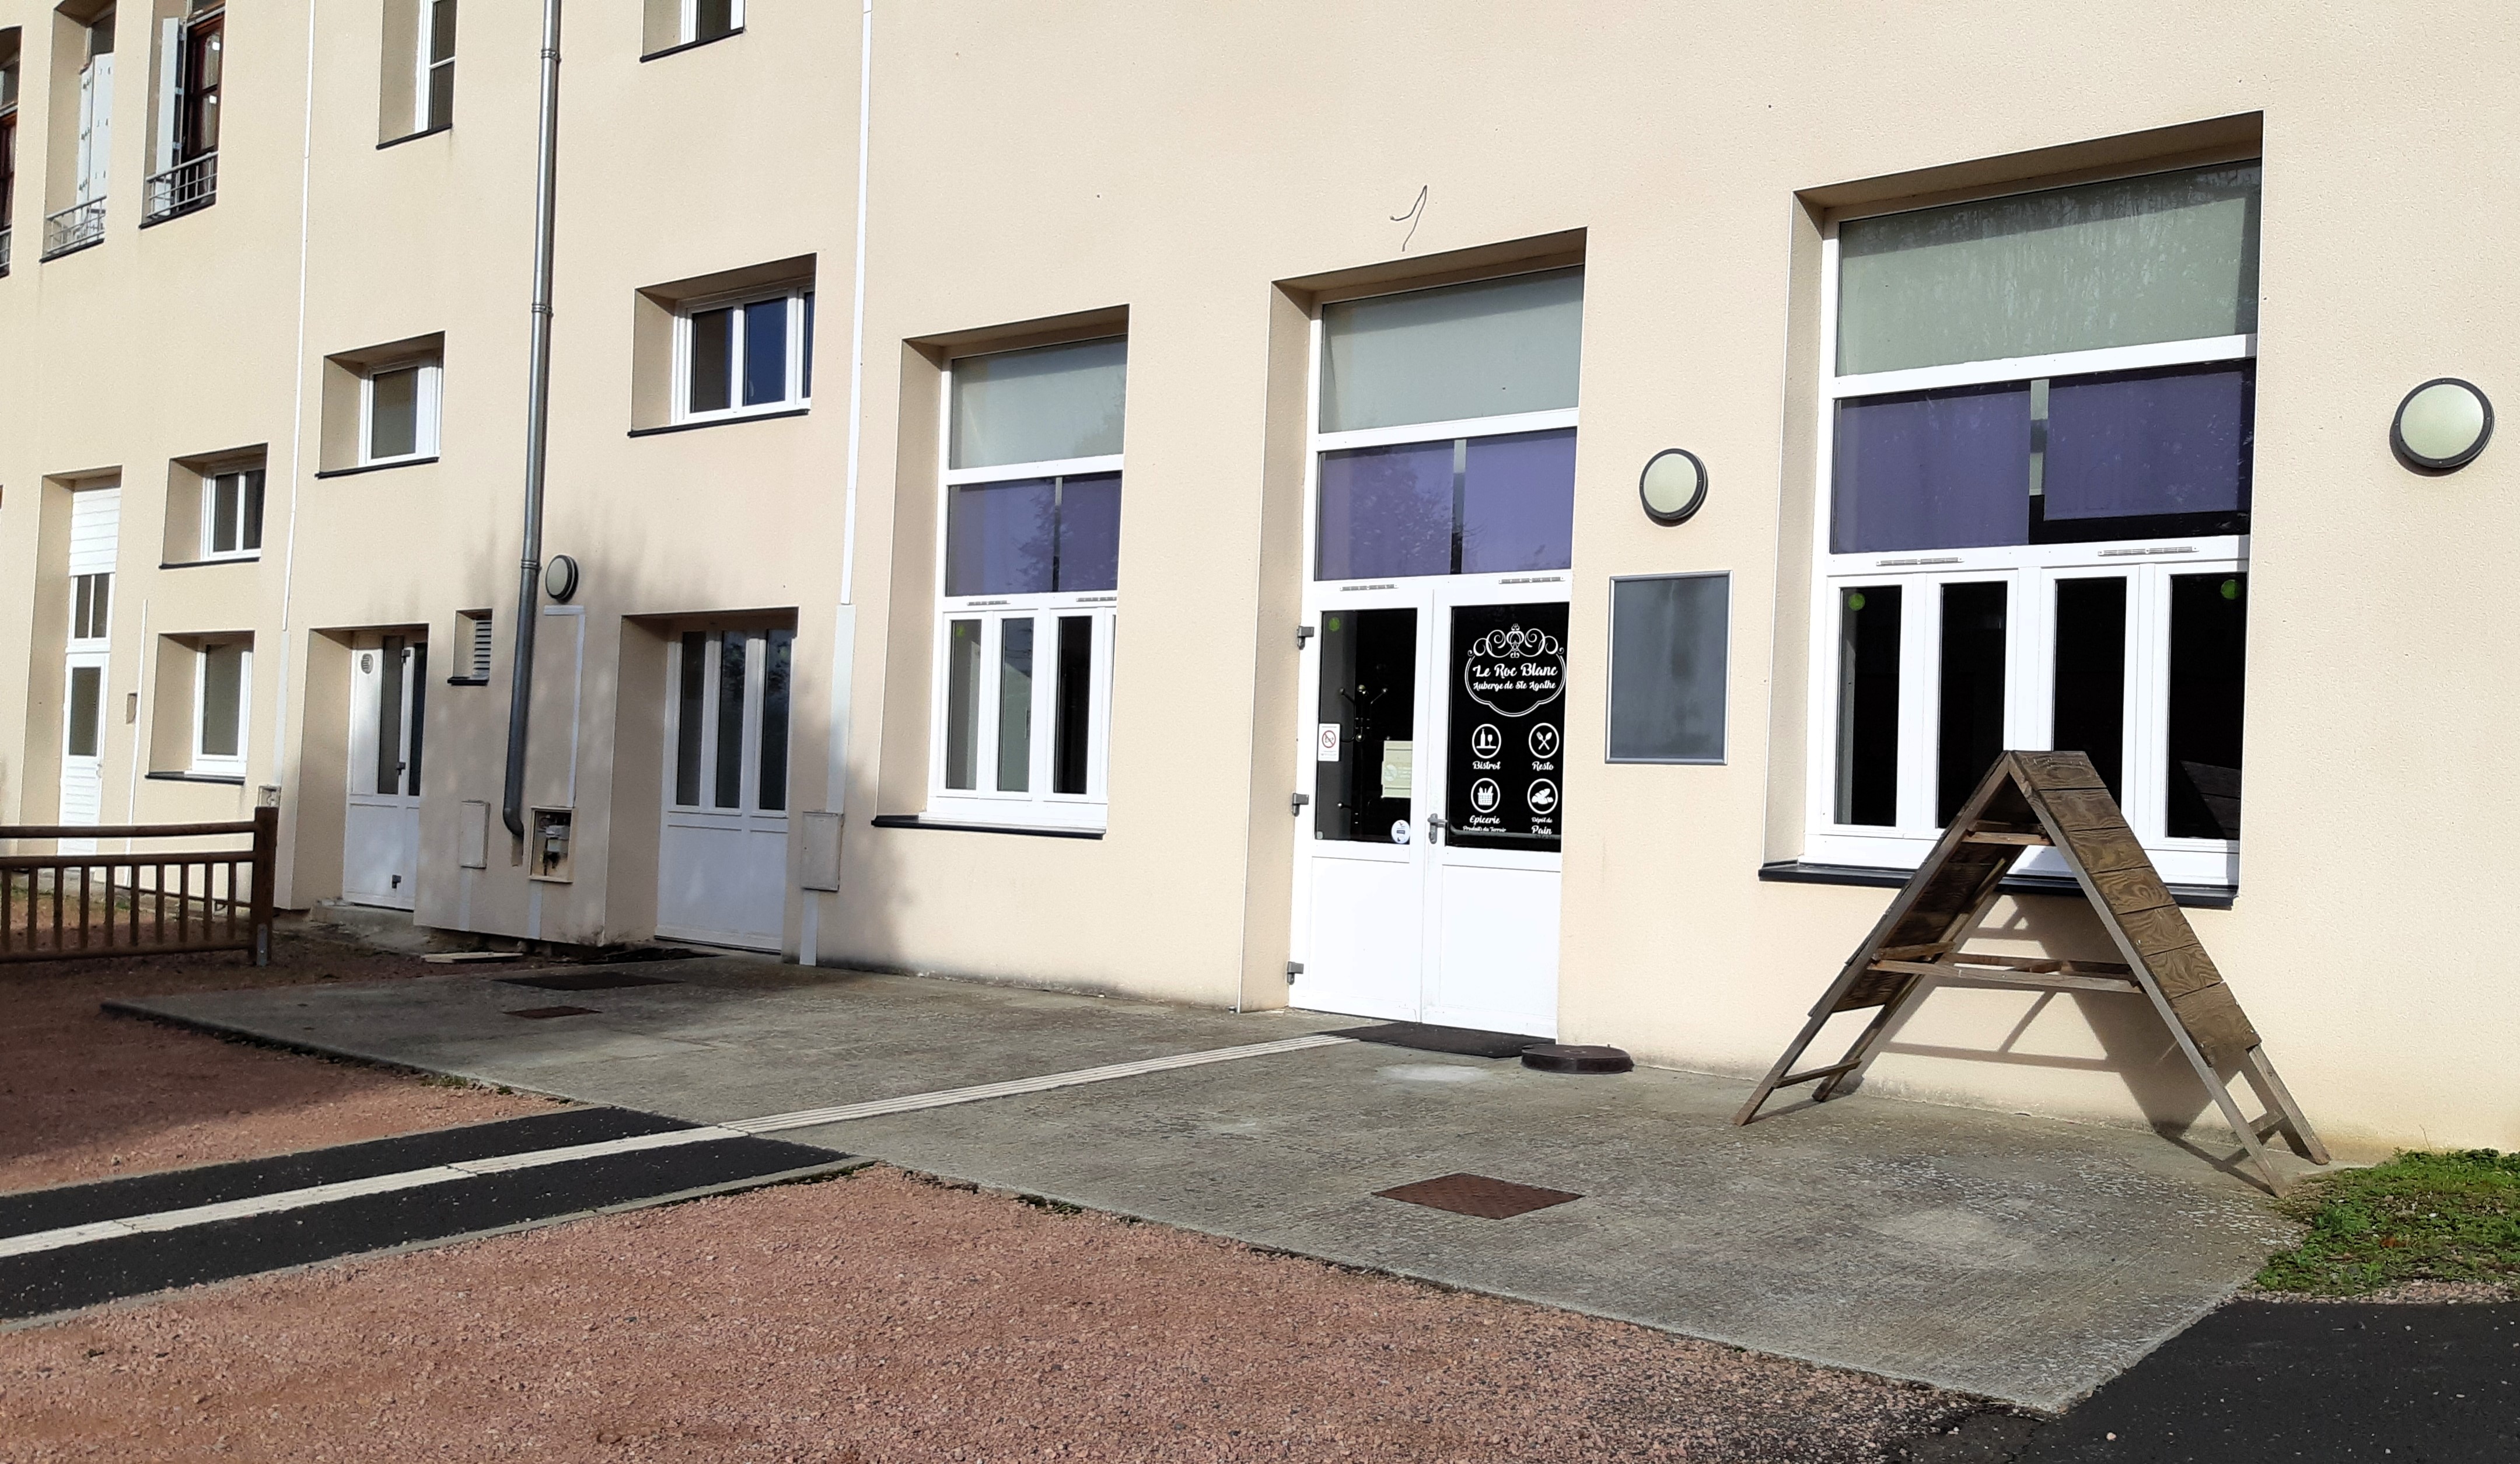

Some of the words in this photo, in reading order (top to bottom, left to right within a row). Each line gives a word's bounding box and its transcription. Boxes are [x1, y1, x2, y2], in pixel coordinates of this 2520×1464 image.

[1473, 665, 1491, 677] Le
[1494, 663, 1517, 679] Roc
[1521, 663, 1558, 676] Blanc
[1473, 681, 1504, 691] Auberge
[1504, 681, 1514, 689] de
[1515, 681, 1527, 689] Ste
[1529, 680, 1556, 691] Agathe
[1473, 761, 1501, 770] Bistrot
[1532, 761, 1554, 771] Resto
[1469, 815, 1500, 826] Epicerie
[1531, 825, 1553, 835] Pain
